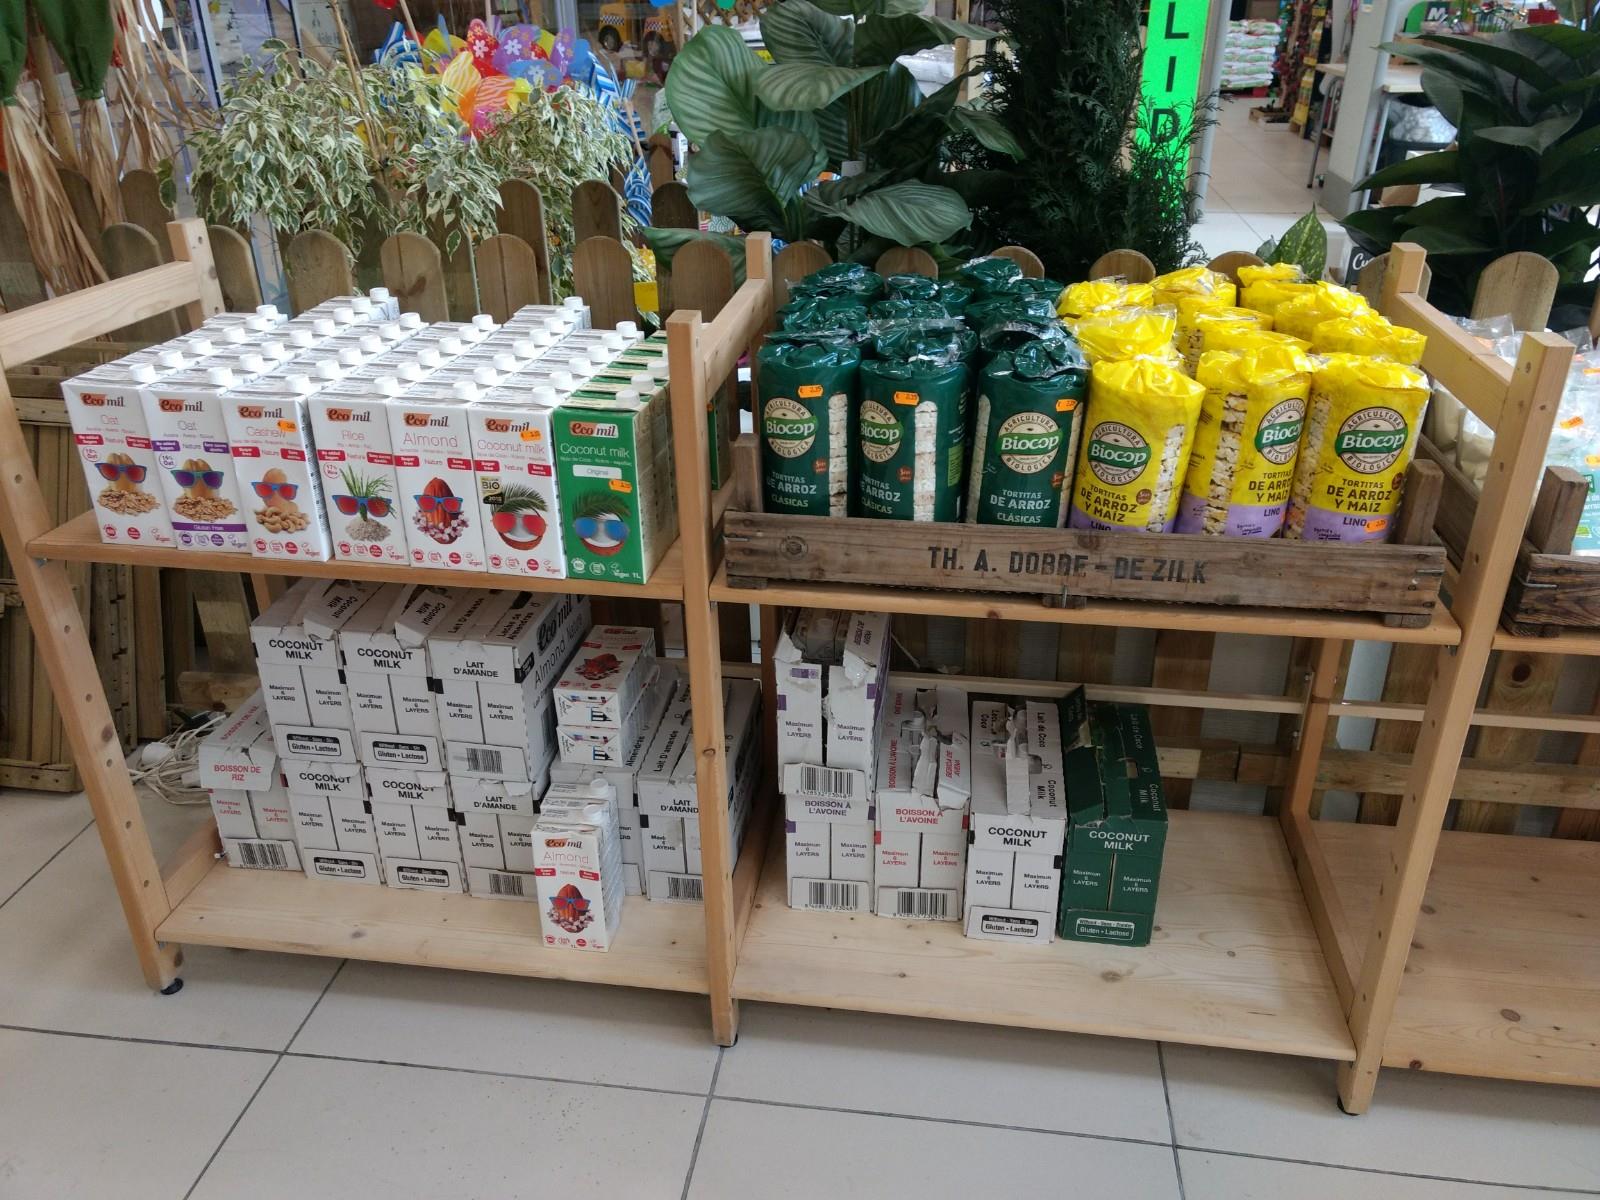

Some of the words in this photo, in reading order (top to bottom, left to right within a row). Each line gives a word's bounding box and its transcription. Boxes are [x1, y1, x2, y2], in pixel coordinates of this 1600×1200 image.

[81, 393, 125, 407] ecomil
[160, 400, 205, 412] ecomil
[238, 406, 286, 418] ecomil
[327, 409, 370, 422] ecomil
[404, 414, 449, 427] ecomil
[485, 419, 530, 432] ecomil
[1004, 415, 1054, 432] AGRICULTURA
[1347, 411, 1402, 430] AGRICULTURA
[571, 423, 616, 436] ecomil
[766, 420, 815, 436] Biocop
[403, 432, 458, 448] Almond
[1095, 424, 1141, 446] AGRICULTURA
[477, 440, 523, 452] Coconut
[525, 444, 545, 455] milk
[1001, 436, 1059, 451] Biocop
[1342, 433, 1405, 450] Biocop
[560, 443, 607, 456] Coconut
[609, 447, 630, 458] milk
[1091, 444, 1147, 465] Biocop
[777, 482, 817, 494] ARROZ
[1249, 480, 1265, 491] DE
[1267, 478, 1293, 490] ARRO
[1343, 478, 1384, 489] TORTITAS
[866, 485, 901, 502] ARROZ
[1003, 489, 1042, 499] TORTITAS
[1090, 484, 1127, 501] TORTITAS
[1257, 493, 1264, 502] Y
[1327, 485, 1345, 497] DE
[1347, 489, 1393, 501] ARROZ
[990, 495, 1006, 506] DE
[1008, 499, 1052, 510] ARROZ
[1081, 487, 1091, 500] DE
[1093, 495, 1138, 513] ARROZ
[1335, 499, 1344, 509] Y
[1085, 502, 1092, 512] Y
[1263, 508, 1280, 517] LINO
[997, 512, 1041, 523] CLÁSICAS
[1343, 517, 1367, 527] LINO
[928, 546, 964, 570] TH.
[974, 549, 998, 573] A.
[1152, 558, 1210, 585] ZILK
[269, 639, 324, 652] COCONUT
[285, 650, 313, 660] MILK
[357, 648, 414, 661] COCONUT
[373, 658, 402, 669] MILK
[466, 660, 485, 669] LAIT
[453, 668, 499, 679] D'AMANDE
[214, 765, 249, 773] BOISSON
[250, 766, 262, 774] DE
[231, 774, 245, 782] RIZ
[299, 772, 351, 784] COCONUT
[315, 782, 342, 792] MILK
[1037, 785, 1046, 800] Milk
[1048, 779, 1057, 807] Coconut
[398, 790, 424, 800] MILK
[1149, 783, 1161, 812] Coconut
[474, 801, 518, 811] D'AMANDE
[660, 805, 699, 814] D'AMAND
[804, 800, 844, 809] BOISSON
[808, 807, 847, 817] L'AVOINE
[895, 808, 935, 817] BOISSON
[899, 816, 939, 825] L'AVOINE
[988, 826, 1048, 839] COCONUT
[1089, 831, 1152, 843] COCONUT
[545, 838, 583, 849] ecomil
[1003, 837, 1032, 847] MILK
[1104, 841, 1134, 851] MILK
[543, 851, 589, 865] Almond
[985, 923, 1005, 932] Gluten
[1010, 926, 1034, 934] Lactose
[1080, 926, 1099, 935] Gluten
[1105, 928, 1130, 936] Lactose
